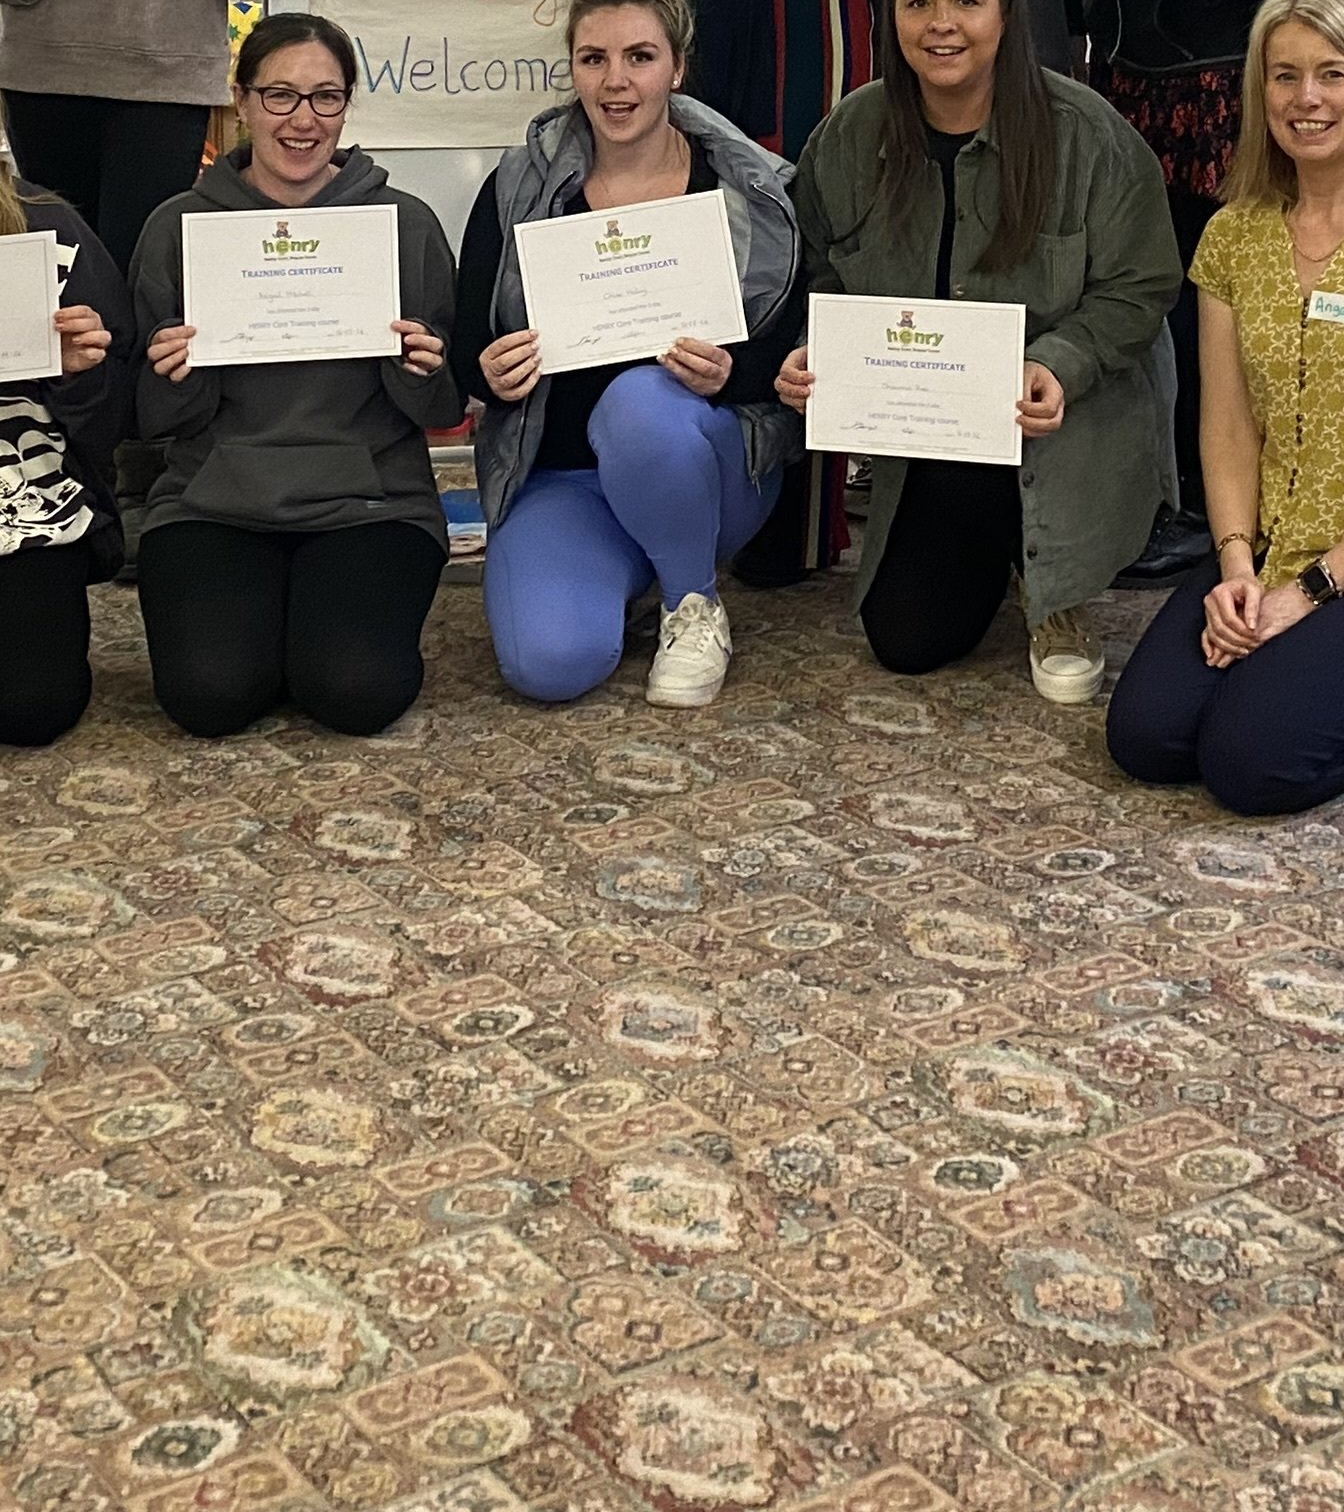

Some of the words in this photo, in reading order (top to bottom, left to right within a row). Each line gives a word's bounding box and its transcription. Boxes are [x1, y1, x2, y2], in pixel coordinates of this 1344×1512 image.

[354, 35, 575, 95] Welcome
[263, 239, 320, 255] henry
[595, 234, 652, 255] henry
[886, 328, 944, 346] henry
